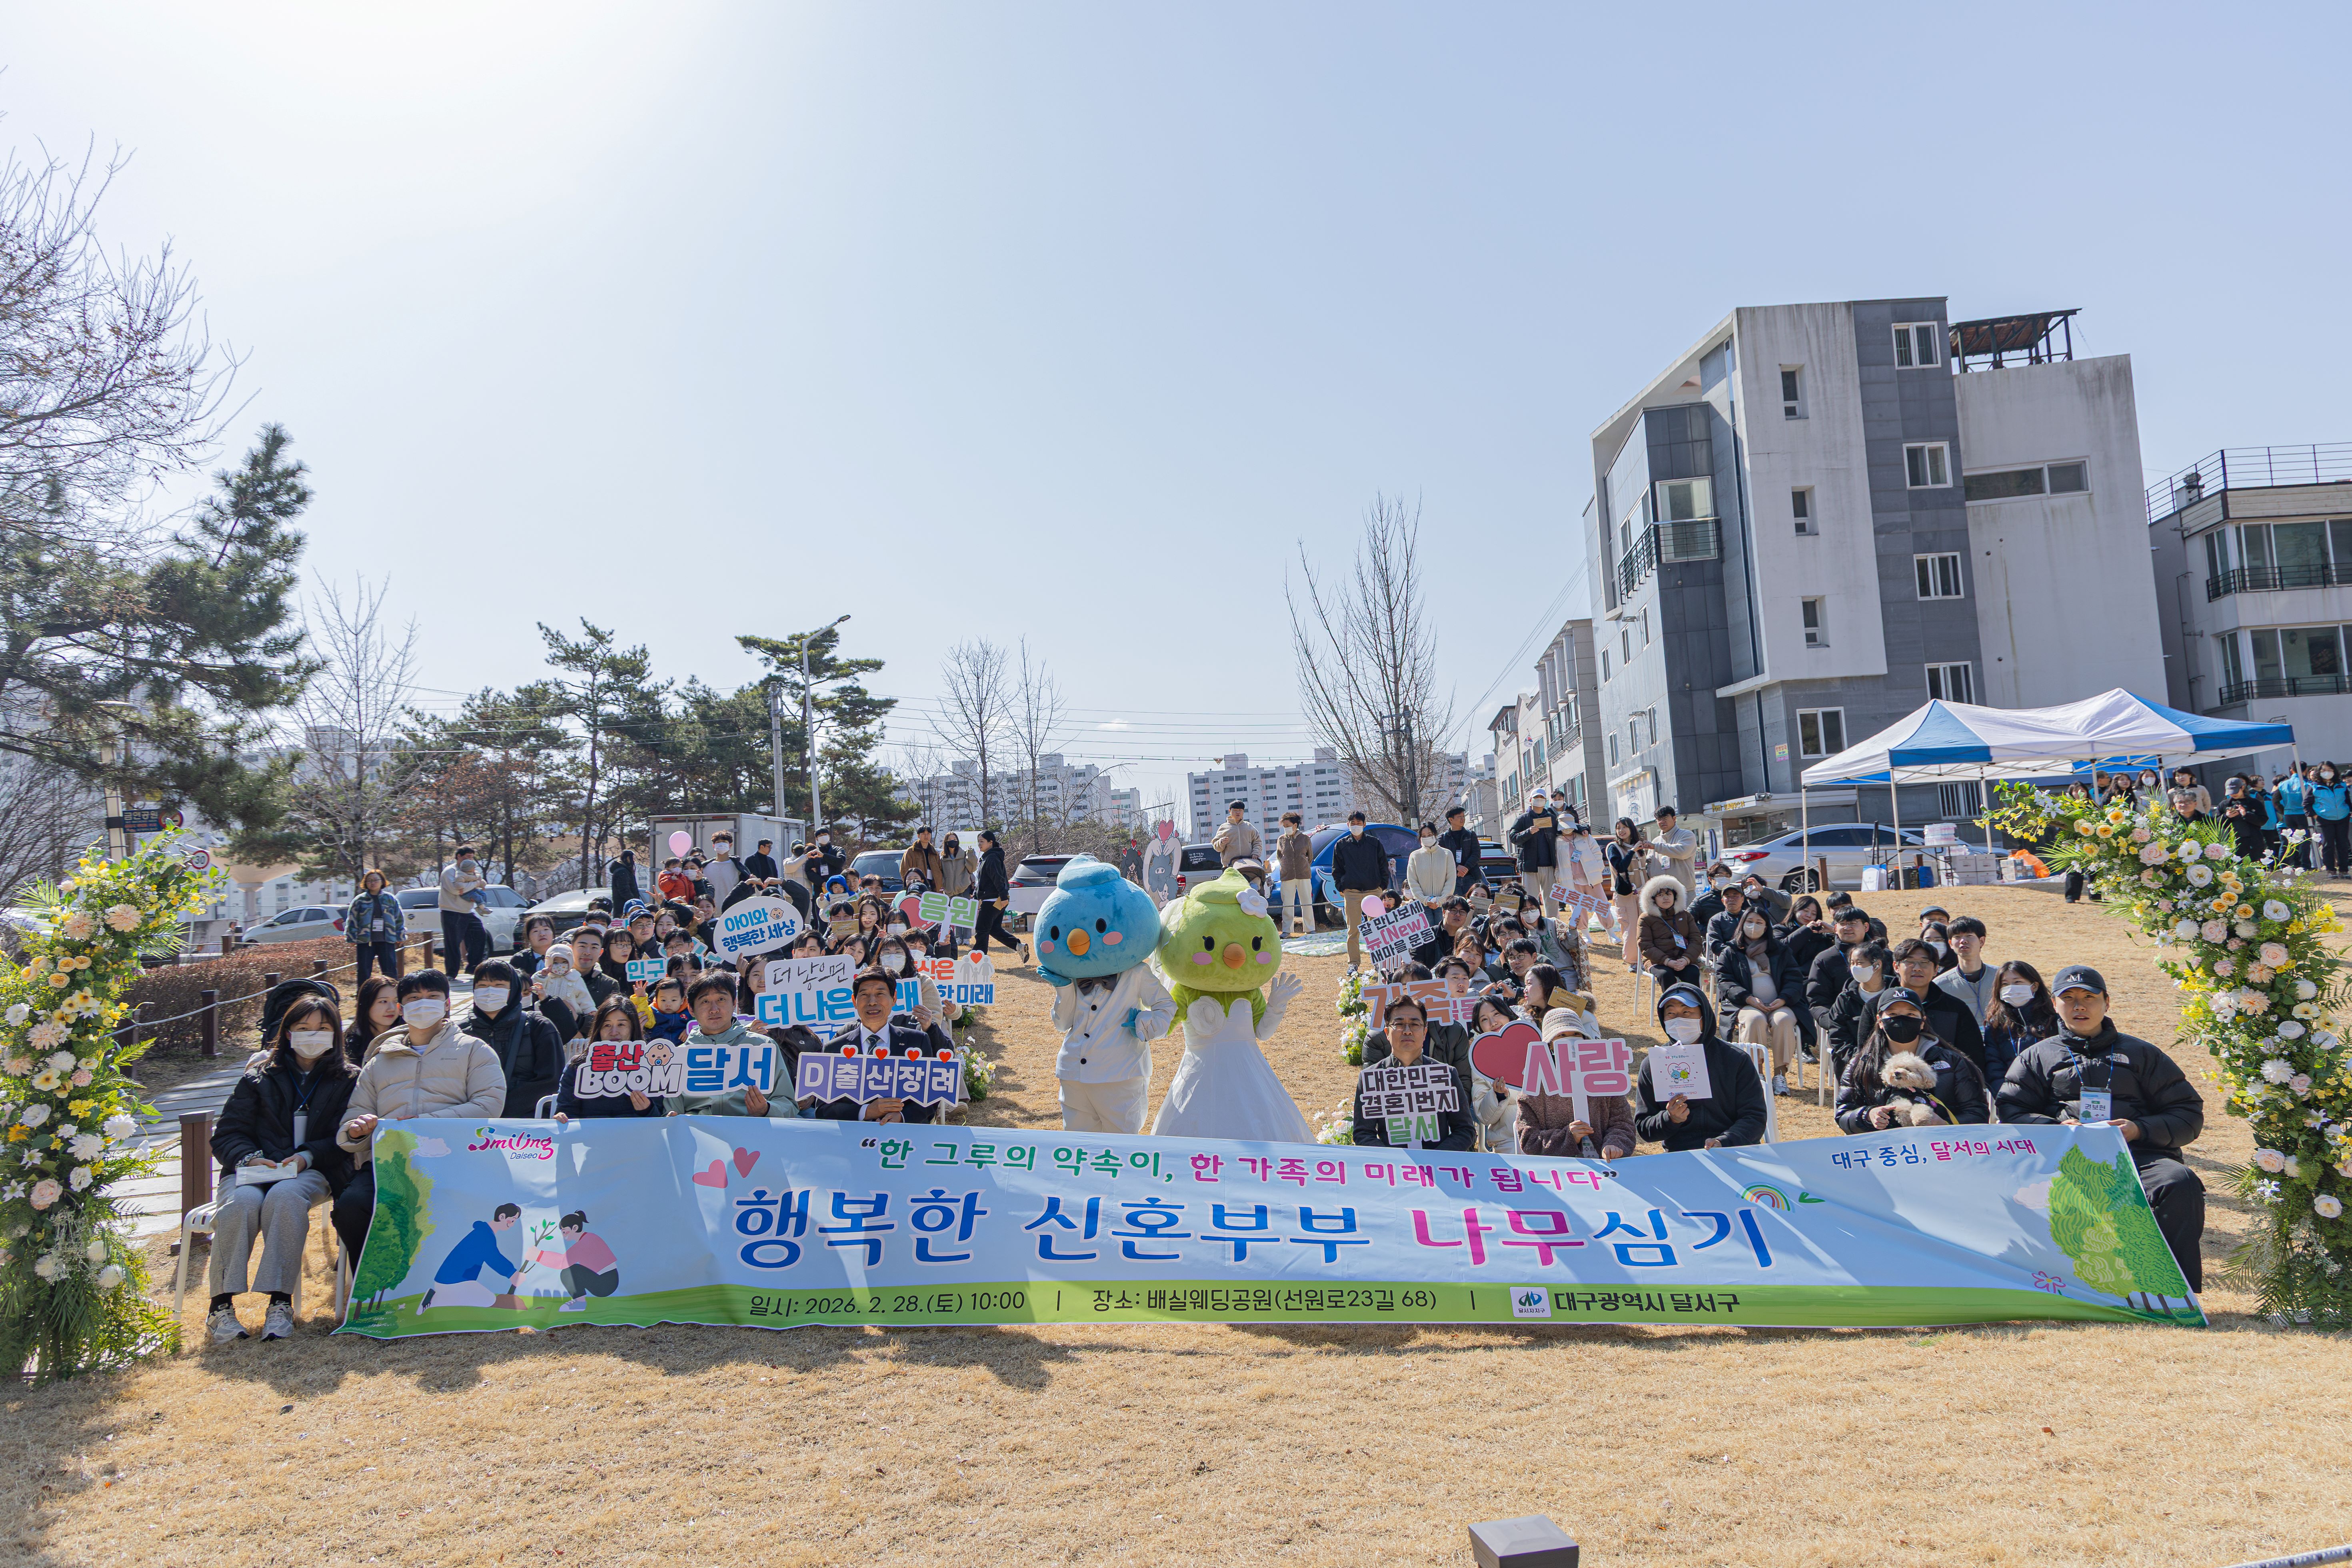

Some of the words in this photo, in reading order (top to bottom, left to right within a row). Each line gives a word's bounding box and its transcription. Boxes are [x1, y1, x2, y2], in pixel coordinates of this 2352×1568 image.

[195, 855, 205, 864] 30
[921, 893, 975, 927] 응원
[1552, 885, 1611, 917] 결혼축복
[725, 908, 768, 932] 아이와
[1359, 922, 1373, 937] 잘
[1373, 901, 1423, 930] 만나보세
[1365, 913, 1428, 951] 뉴(New)
[721, 927, 766, 952] 행복한
[767, 919, 795, 939] 세상
[1371, 939, 1408, 963] 새마을
[1409, 928, 1434, 947] 운동
[773, 967, 791, 985] 더
[913, 960, 955, 980] 산은
[759, 993, 789, 1025] 더
[795, 988, 855, 1021] 나은
[957, 984, 993, 1004] 미래
[580, 1064, 682, 1094] BOOM
[591, 1044, 644, 1072] 출산
[687, 1047, 772, 1092] 달서
[1364, 1066, 1449, 1092] 대한민국
[1528, 1041, 1629, 1095] 사랑
[468, 1127, 553, 1160] Smiling
[1387, 1115, 1439, 1143] 달서
[925, 1143, 1036, 1171] 그루의
[1053, 1147, 1173, 1182] 약속이,
[1190, 1153, 1224, 1182] 한
[1238, 1157, 1345, 1186] 가족의
[1365, 1163, 1475, 1188] 미래가
[1832, 1150, 1872, 1169] 대구
[1878, 1143, 1926, 1167] 중심,
[1930, 1141, 1990, 1161] 달서의
[1996, 1139, 2037, 1156] 시대
[735, 1189, 988, 1268] 행복한
[1024, 1196, 1370, 1264] 신혼부부
[749, 1295, 799, 1317] 일시:
[805, 1297, 861, 1314] 2026.
[868, 1296, 885, 1313] 2.
[893, 1292, 963, 1314] 28.(토)
[971, 1292, 1025, 1310] 10:00
[1093, 1290, 1140, 1312] 장소:
[1401, 1290, 1437, 1310] 68)
[1554, 1292, 1665, 1312] 대구광역시
[1672, 1293, 1741, 1313] 달서구
